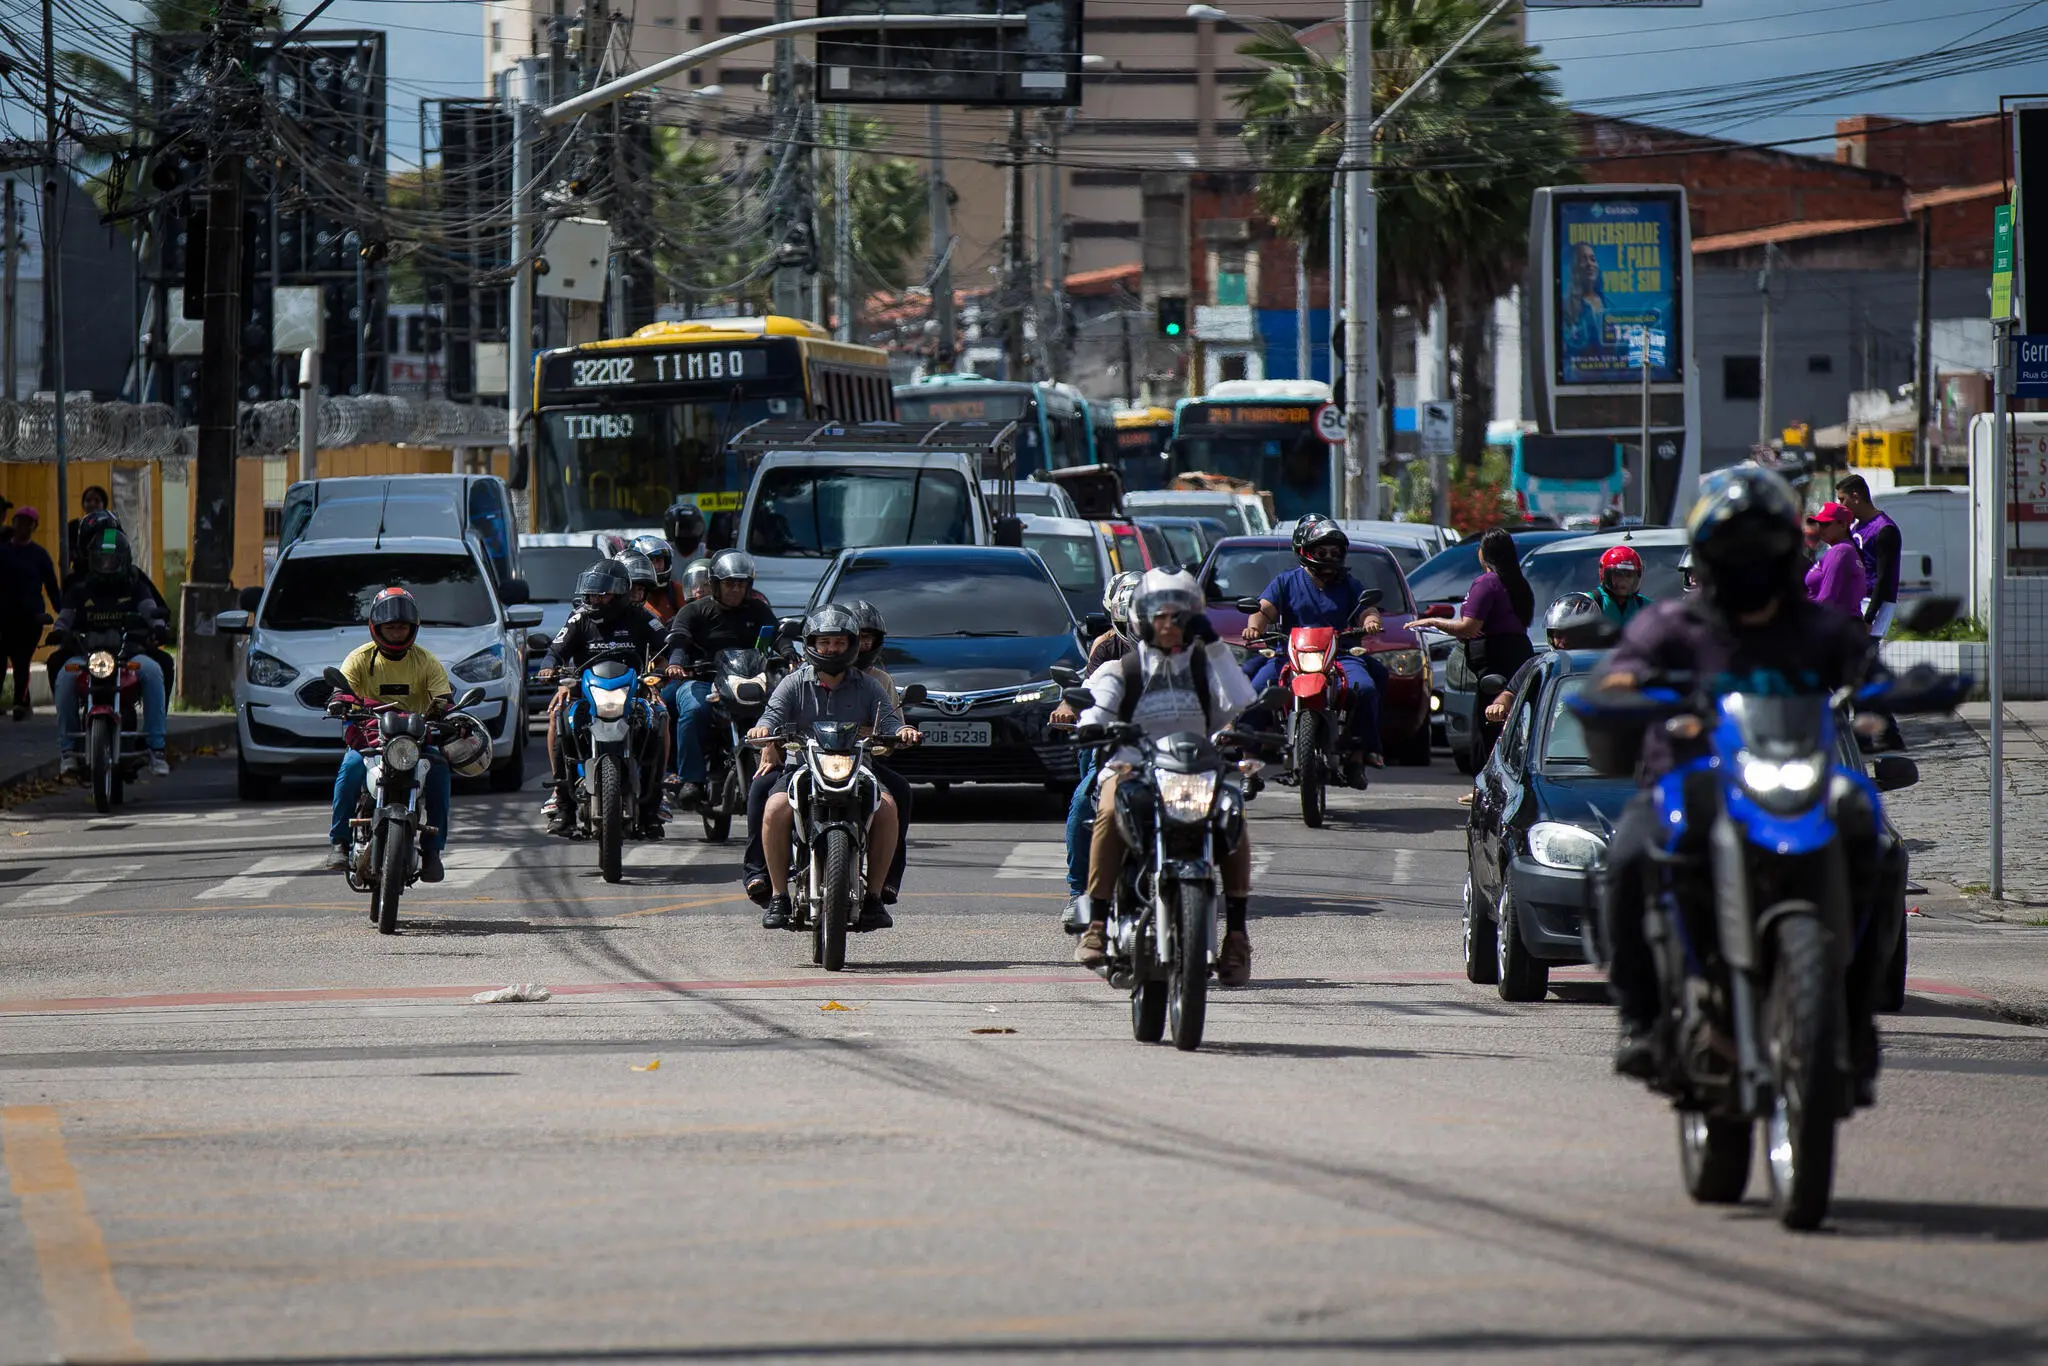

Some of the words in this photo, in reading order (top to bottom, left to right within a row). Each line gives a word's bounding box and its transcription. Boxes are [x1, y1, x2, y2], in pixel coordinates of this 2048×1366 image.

[1568, 222, 1660, 246] UNIVERSIDADE
[1626, 245, 1660, 270] PARA
[1638, 270, 1661, 291] SIM
[2022, 340, 2048, 362] Ger
[572, 357, 636, 387] 32202
[653, 350, 744, 382] TIMBO
[2022, 371, 2039, 379] Rua
[2040, 371, 2048, 379] G
[563, 413, 635, 440] TIMBO
